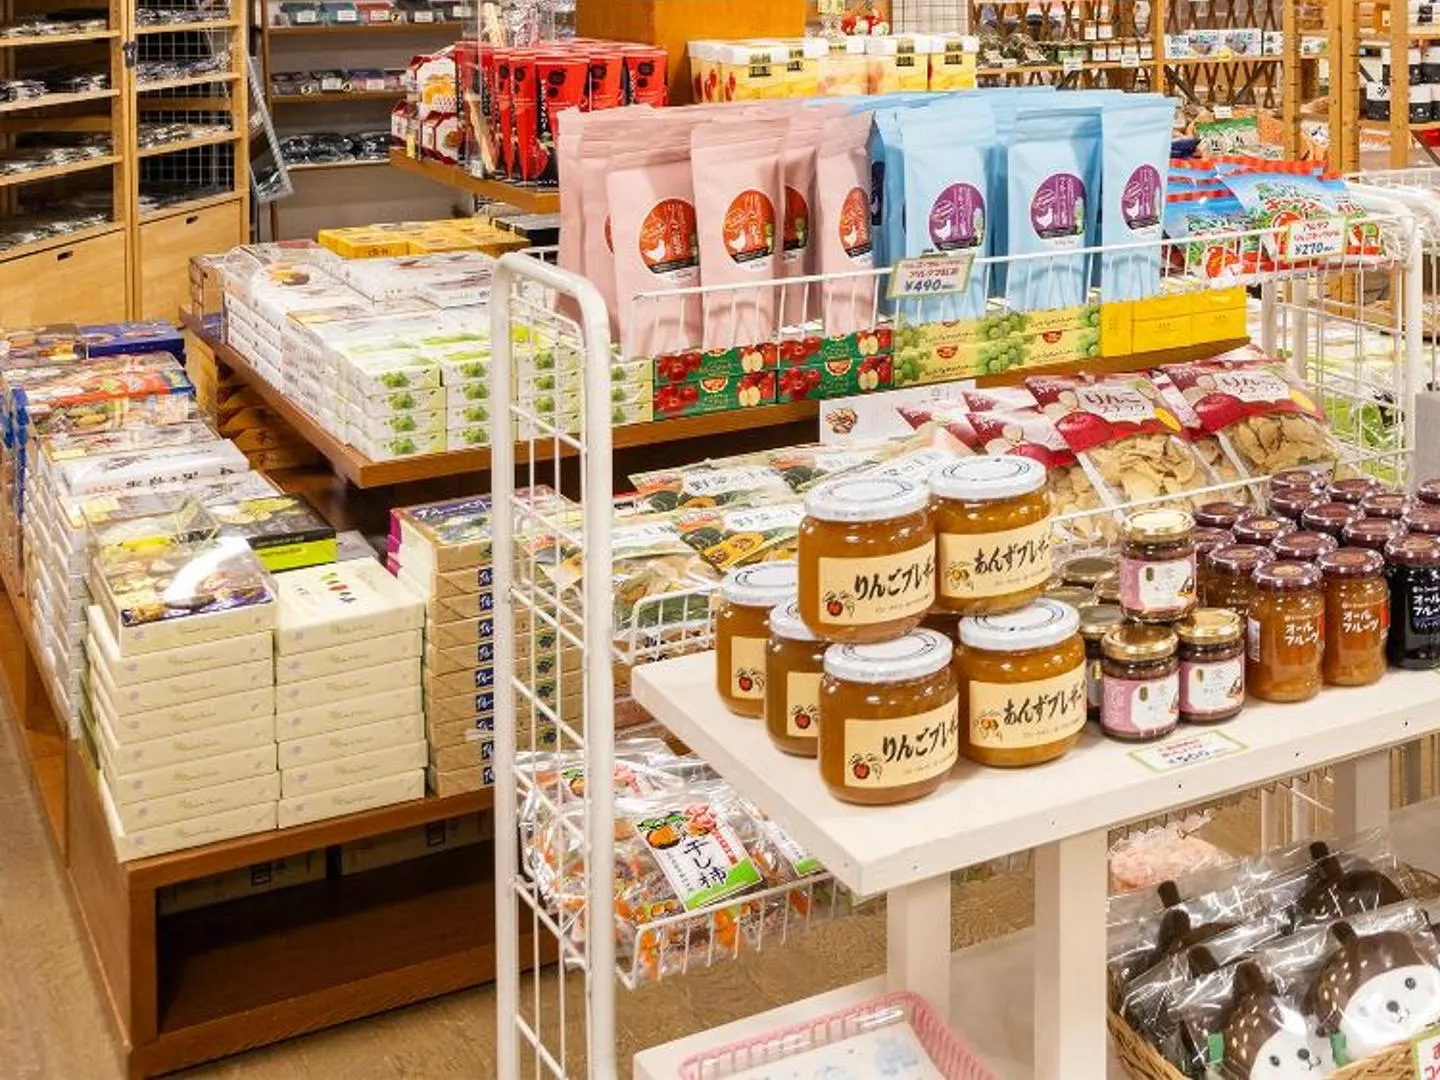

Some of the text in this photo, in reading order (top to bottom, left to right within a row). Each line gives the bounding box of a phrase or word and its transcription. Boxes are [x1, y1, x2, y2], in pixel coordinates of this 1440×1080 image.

[905, 279, 941, 291] ¥490
[1412, 594, 1440, 605] オール
[1343, 610, 1372, 622] オール
[1285, 622, 1314, 635] オール
